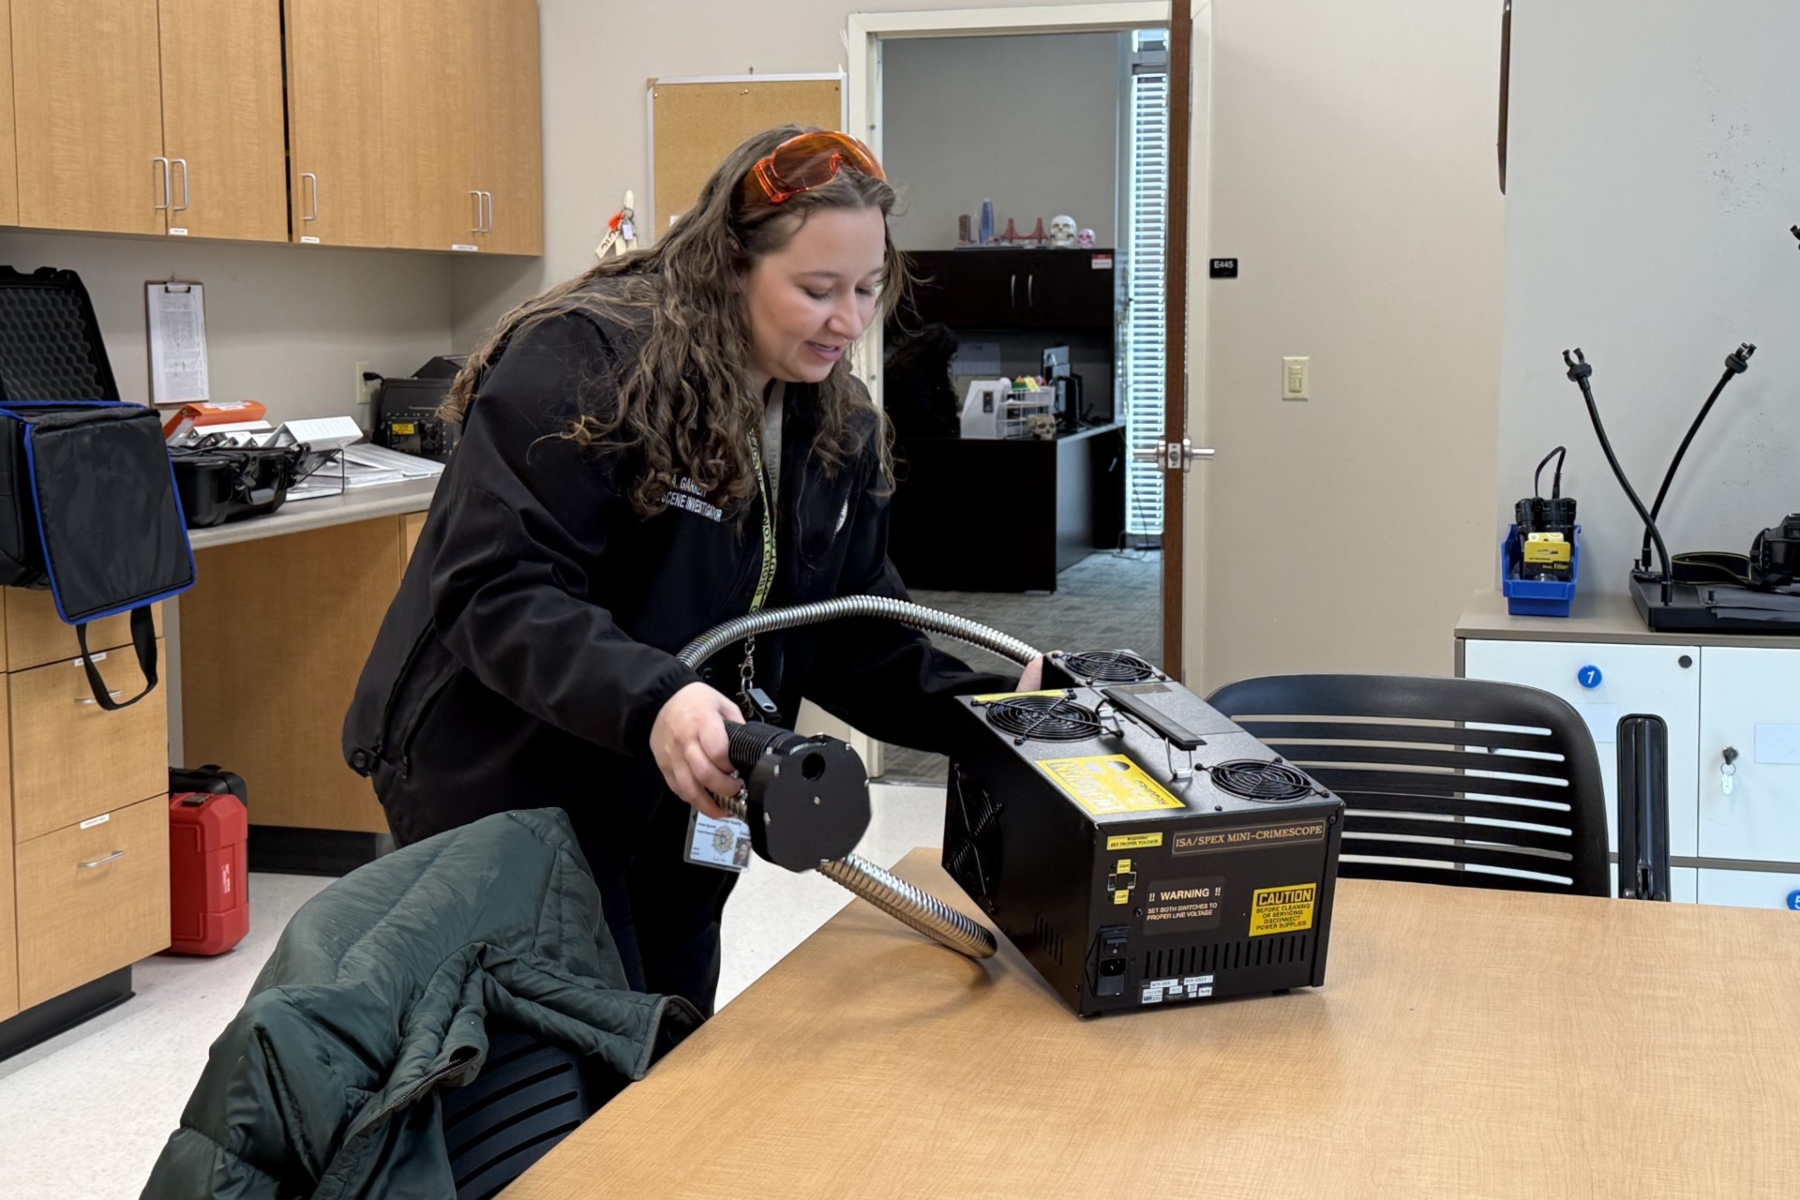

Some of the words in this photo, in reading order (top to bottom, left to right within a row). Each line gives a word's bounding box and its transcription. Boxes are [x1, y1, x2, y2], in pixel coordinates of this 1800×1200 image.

[1213, 260, 1234, 269] E445
[1587, 670, 1595, 684] 1
[1175, 834, 1225, 848] ISA/SPEX
[1227, 825, 1323, 843] MINI-CRIMESCOPE
[1160, 888, 1210, 901] WARNING
[1258, 888, 1312, 906] CAUTION
[1160, 905, 1178, 913] BOTH
[1177, 902, 1208, 912] SWITCHES
[1256, 906, 1280, 914] BEFORE
[1280, 903, 1310, 911] CLEANING
[1146, 913, 1172, 922] PROPER
[1172, 911, 1186, 919] LINE
[1186, 909, 1213, 918] VOLTAGE
[1272, 909, 1303, 918] SERVICING
[1263, 916, 1301, 925] DISCONNECT
[1256, 923, 1278, 931] POWER
